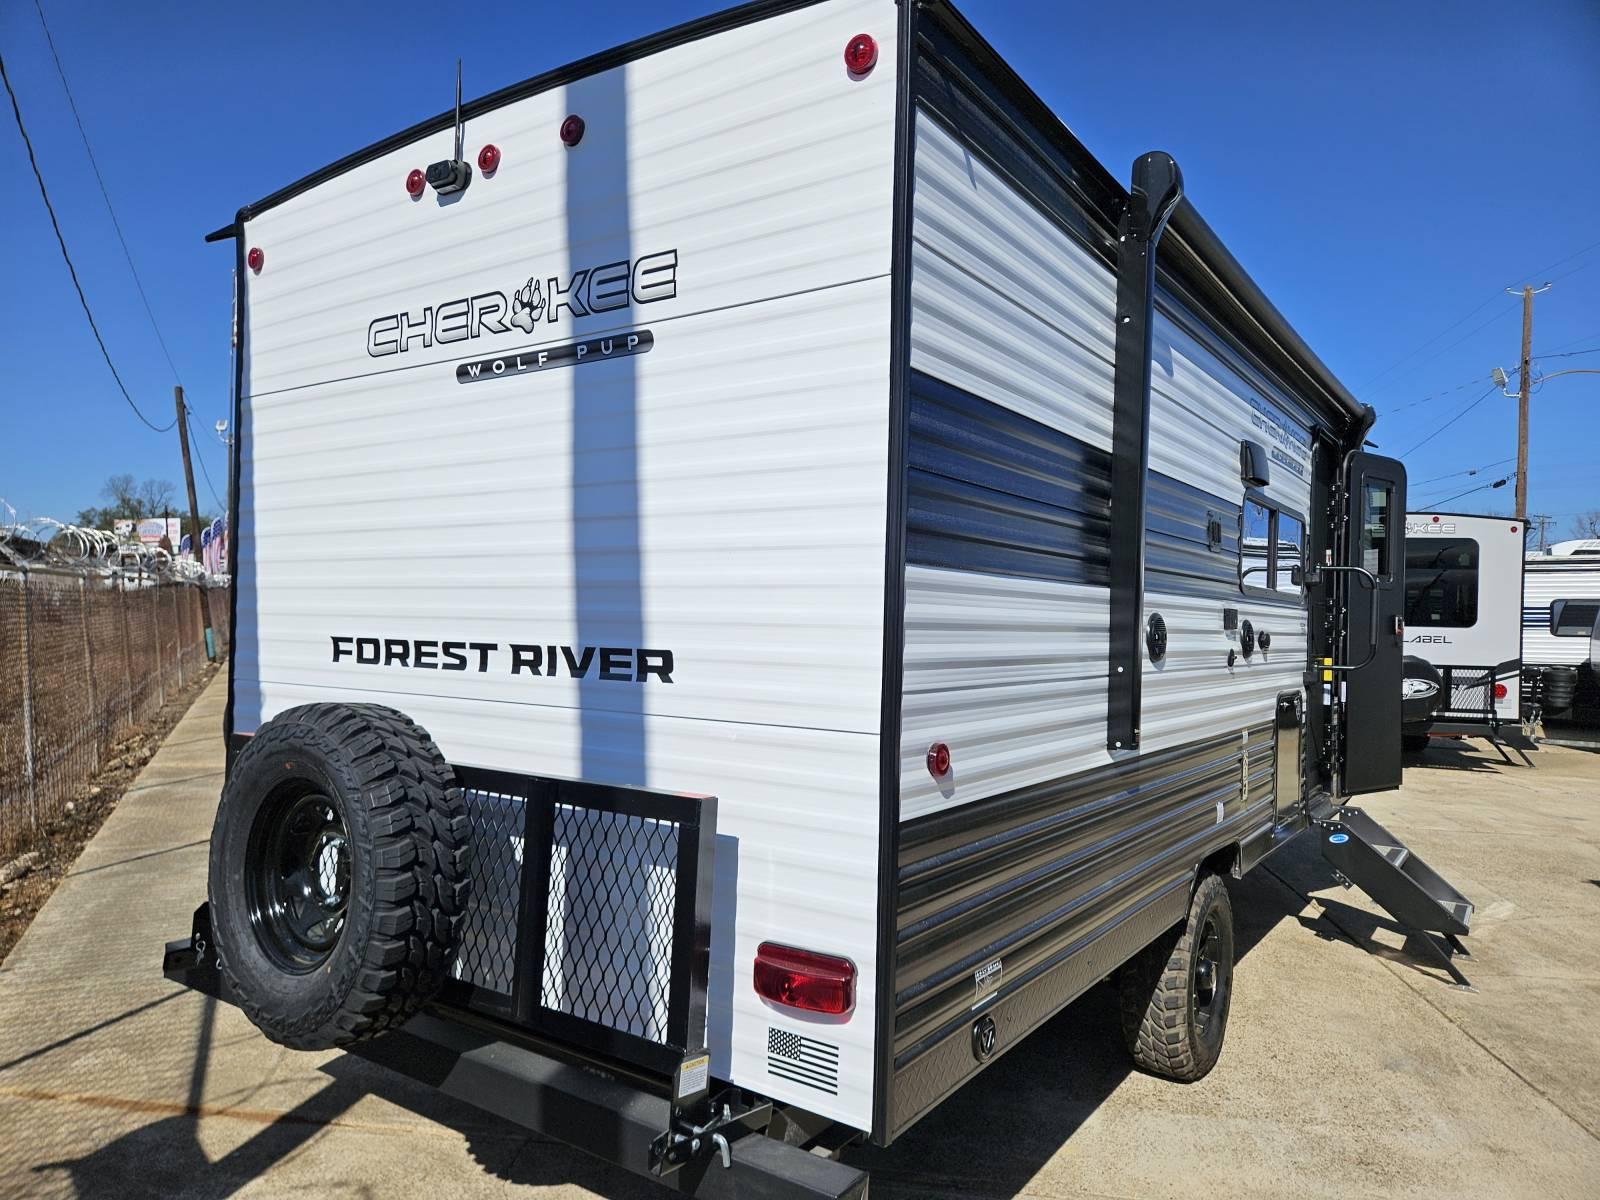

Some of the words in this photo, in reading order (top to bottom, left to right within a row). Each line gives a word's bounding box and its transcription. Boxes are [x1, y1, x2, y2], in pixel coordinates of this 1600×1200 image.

[367, 249, 678, 358] CHEROKEE
[467, 352, 548, 378] WOLF
[576, 335, 640, 360] PUP
[330, 636, 498, 673] FOREST
[508, 643, 675, 684] RIVER
